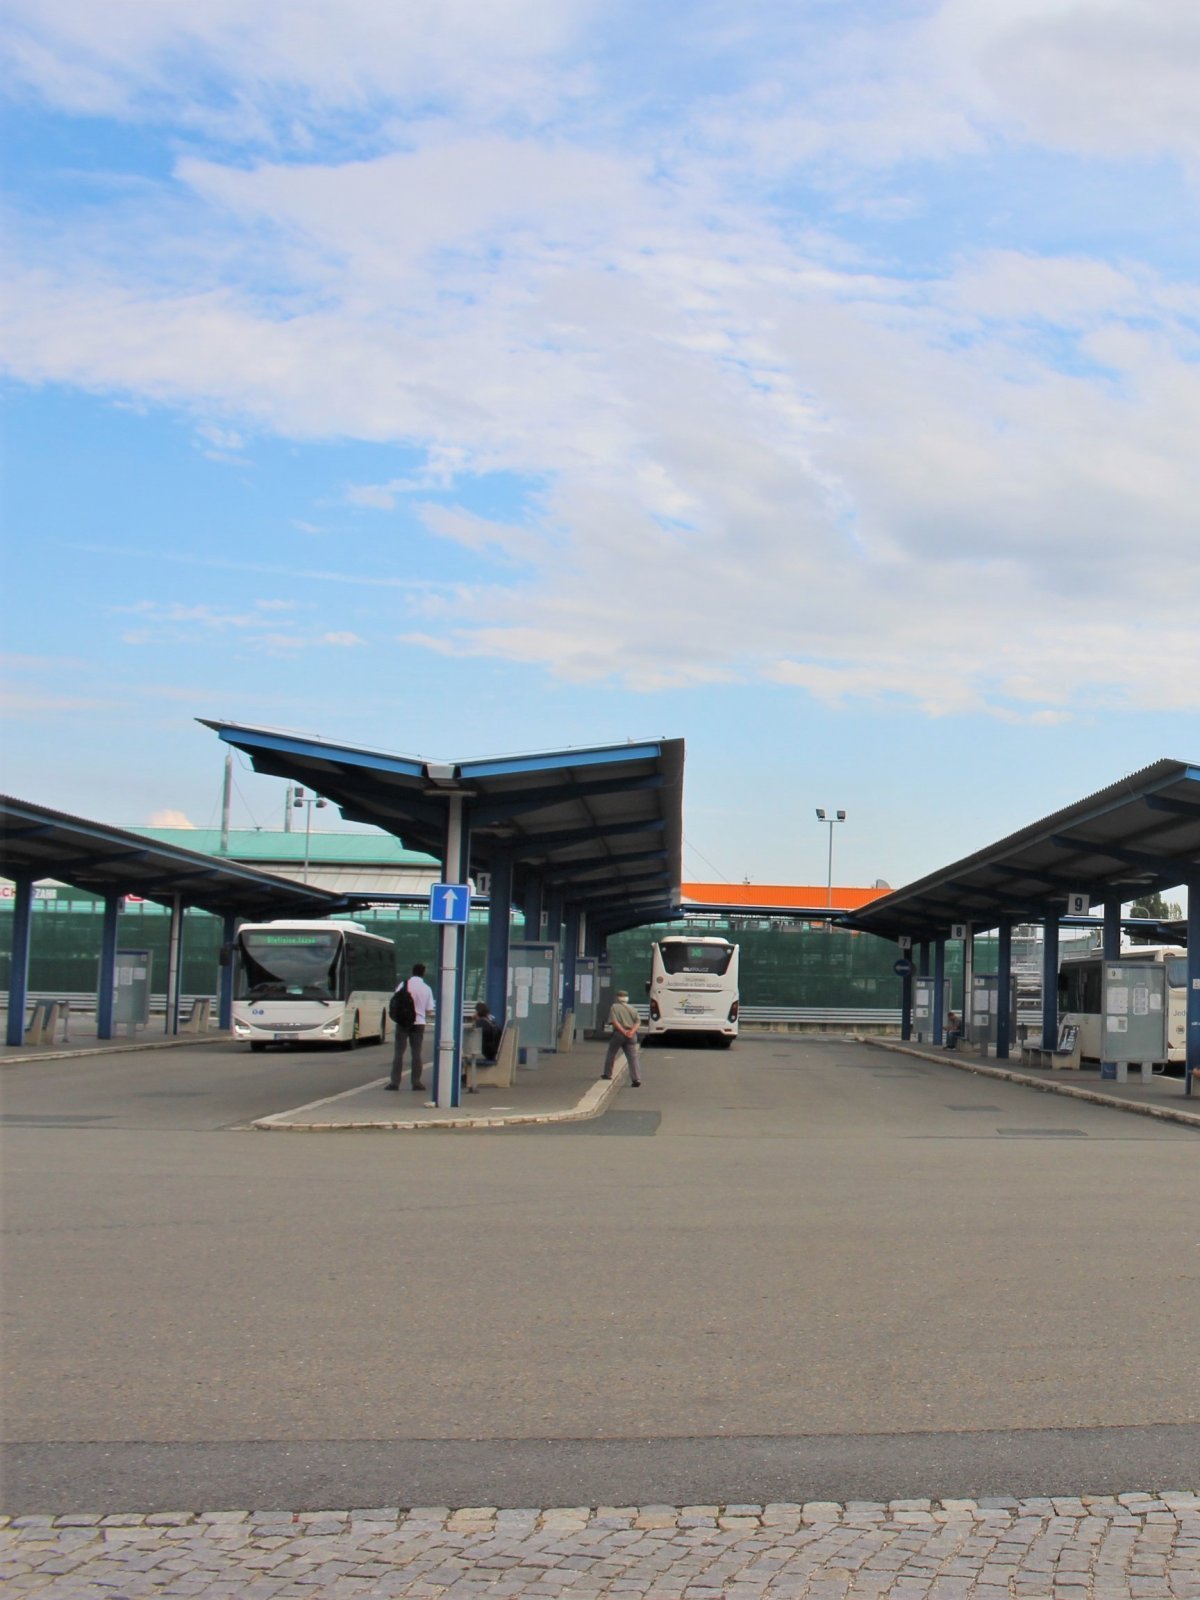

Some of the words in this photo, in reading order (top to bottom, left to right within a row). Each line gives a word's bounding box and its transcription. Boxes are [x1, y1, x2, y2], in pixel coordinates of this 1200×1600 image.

[1074, 897, 1083, 911] 9
[955, 926, 962, 938] 8
[901, 938, 907, 947] 7
